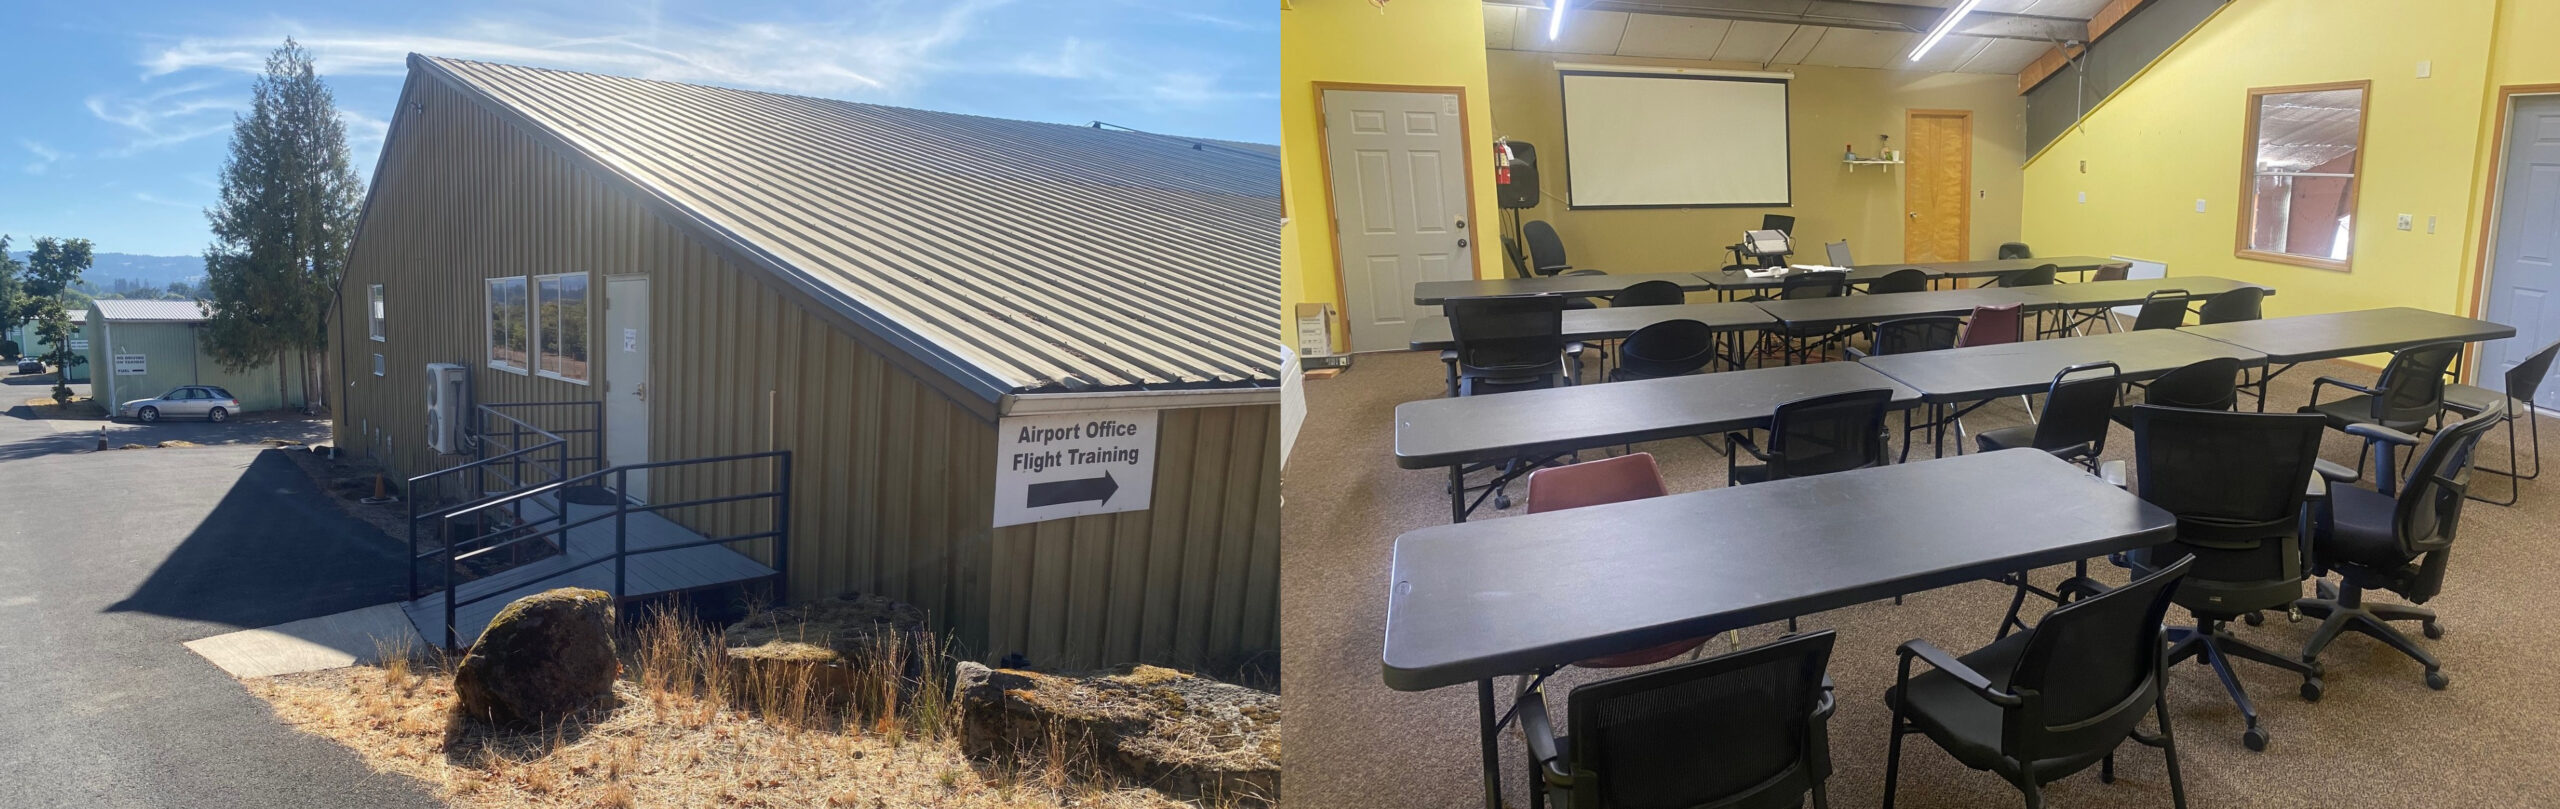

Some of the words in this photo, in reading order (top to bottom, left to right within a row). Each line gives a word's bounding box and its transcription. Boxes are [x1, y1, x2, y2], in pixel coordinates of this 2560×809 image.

[1018, 423, 1080, 446] Airport
[1086, 420, 1137, 439] Office
[1012, 450, 1062, 473] Flight
[1068, 446, 1139, 465] Training
